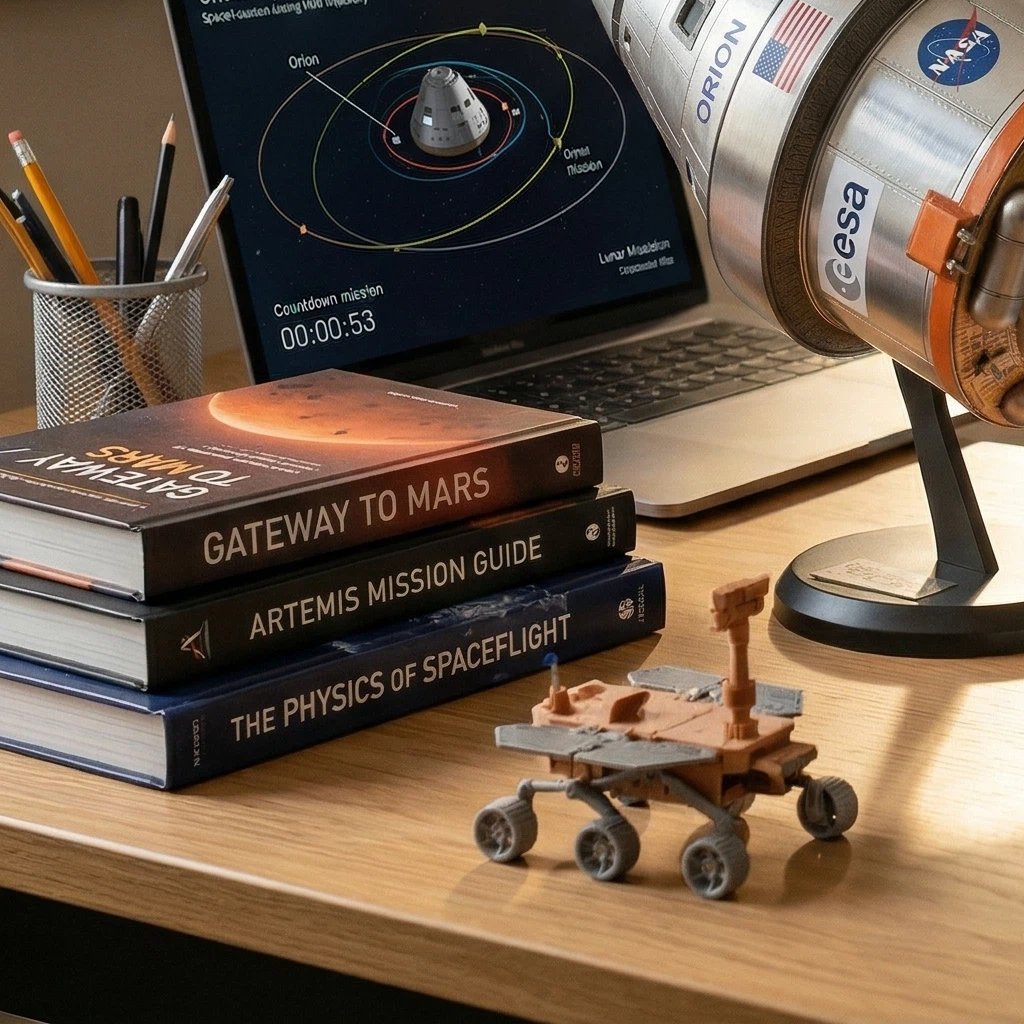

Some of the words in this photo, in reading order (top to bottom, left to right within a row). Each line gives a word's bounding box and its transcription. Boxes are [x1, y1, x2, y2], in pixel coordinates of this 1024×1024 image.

[288, 53, 319, 70] Orion
[696, 18, 748, 125] ORION
[928, 29, 992, 77] NASA
[833, 180, 870, 267] esa
[273, 294, 338, 318] Countdown
[280, 309, 376, 350] 00:00:53
[15, 453, 209, 500] GATEWAY
[85, 445, 205, 476] MARS
[188, 469, 251, 487] TO
[204, 499, 349, 568] GATEWAY
[359, 488, 397, 525] TO
[407, 466, 491, 517] MARS
[249, 585, 360, 640] ARTEMIS
[368, 558, 466, 606] MISSION
[473, 534, 543, 575] GUIDE
[231, 707, 276, 743] THE
[283, 670, 386, 729] PHYSICS
[391, 665, 417, 693] OF
[422, 613, 572, 684] SPACEFLIGHT
